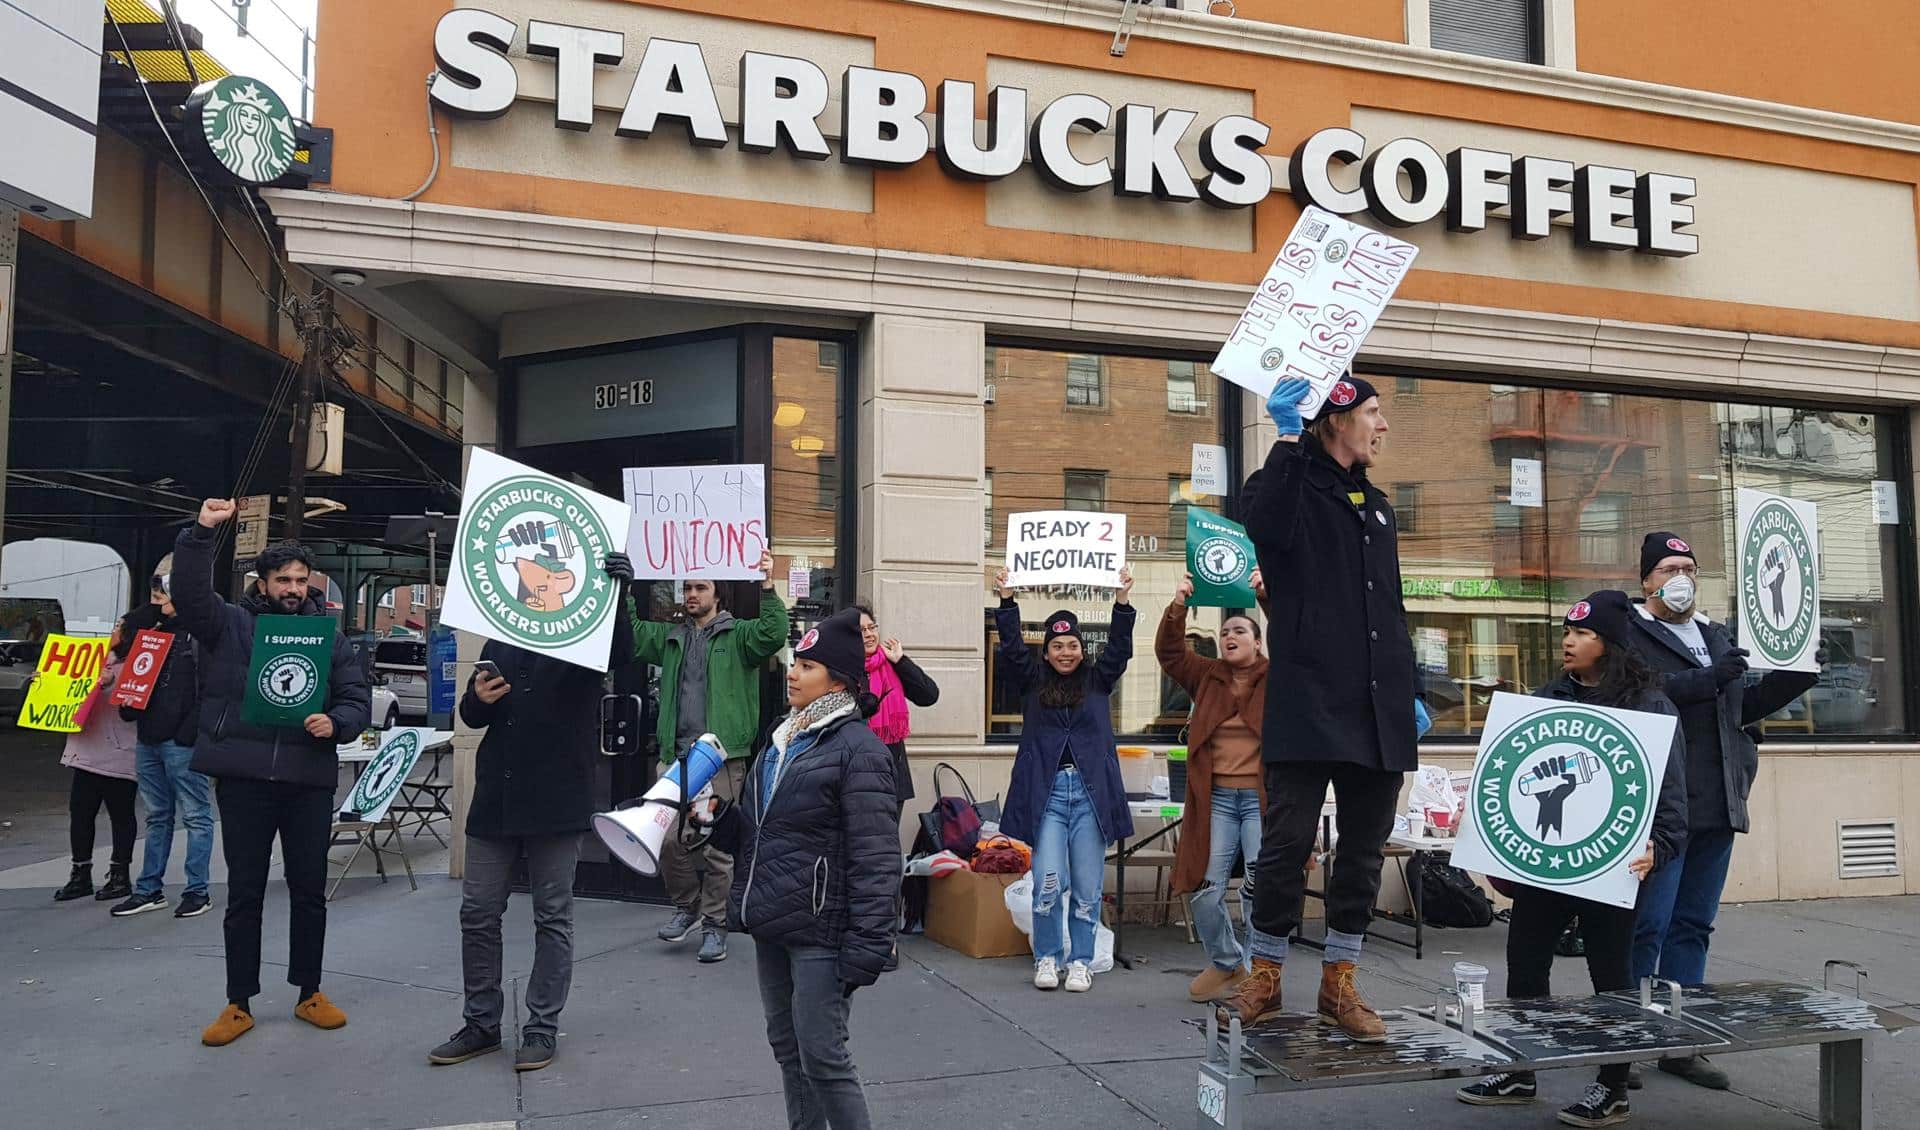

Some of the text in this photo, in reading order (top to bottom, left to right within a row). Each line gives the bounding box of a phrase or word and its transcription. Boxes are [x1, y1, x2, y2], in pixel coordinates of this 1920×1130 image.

[430, 8, 1699, 256] STARBUCKS COFFEE
[1333, 232, 1415, 307] WAR
[1229, 278, 1295, 347] THIS
[1276, 242, 1317, 279] IS
[1288, 303, 1319, 329] A
[596, 381, 652, 408] 30-18
[1196, 464, 1211, 472] Are
[1198, 451, 1213, 460] WE
[1515, 464, 1528, 473] WE
[632, 469, 743, 516] Honk 4
[1195, 479, 1215, 487] open
[1515, 491, 1532, 499] open
[477, 488, 606, 571] STARBUCKS QUEENS
[1020, 521, 1113, 542] READY 2
[1202, 522, 1245, 538] SUPPORT
[1752, 511, 1807, 559] STARBUCKS
[644, 519, 764, 575] UNIONS
[1128, 535, 1158, 552] EAD
[1202, 539, 1240, 553] STARBUCKS
[1013, 549, 1117, 572] NEGOTIATE
[1197, 556, 1245, 582] WORKERS UNITED
[473, 561, 598, 636] WORKERS UNITED
[1745, 574, 1813, 651] WORKERS UNITED
[265, 635, 324, 645] I SUPPORT
[43, 641, 108, 679] HON
[269, 656, 312, 671] STARBUCKS
[67, 678, 92, 698] FOR
[261, 677, 315, 704] WORKERS UNITED
[1511, 719, 1636, 776] STARBUCKS
[1482, 777, 1637, 868] WORKERS UNITED
